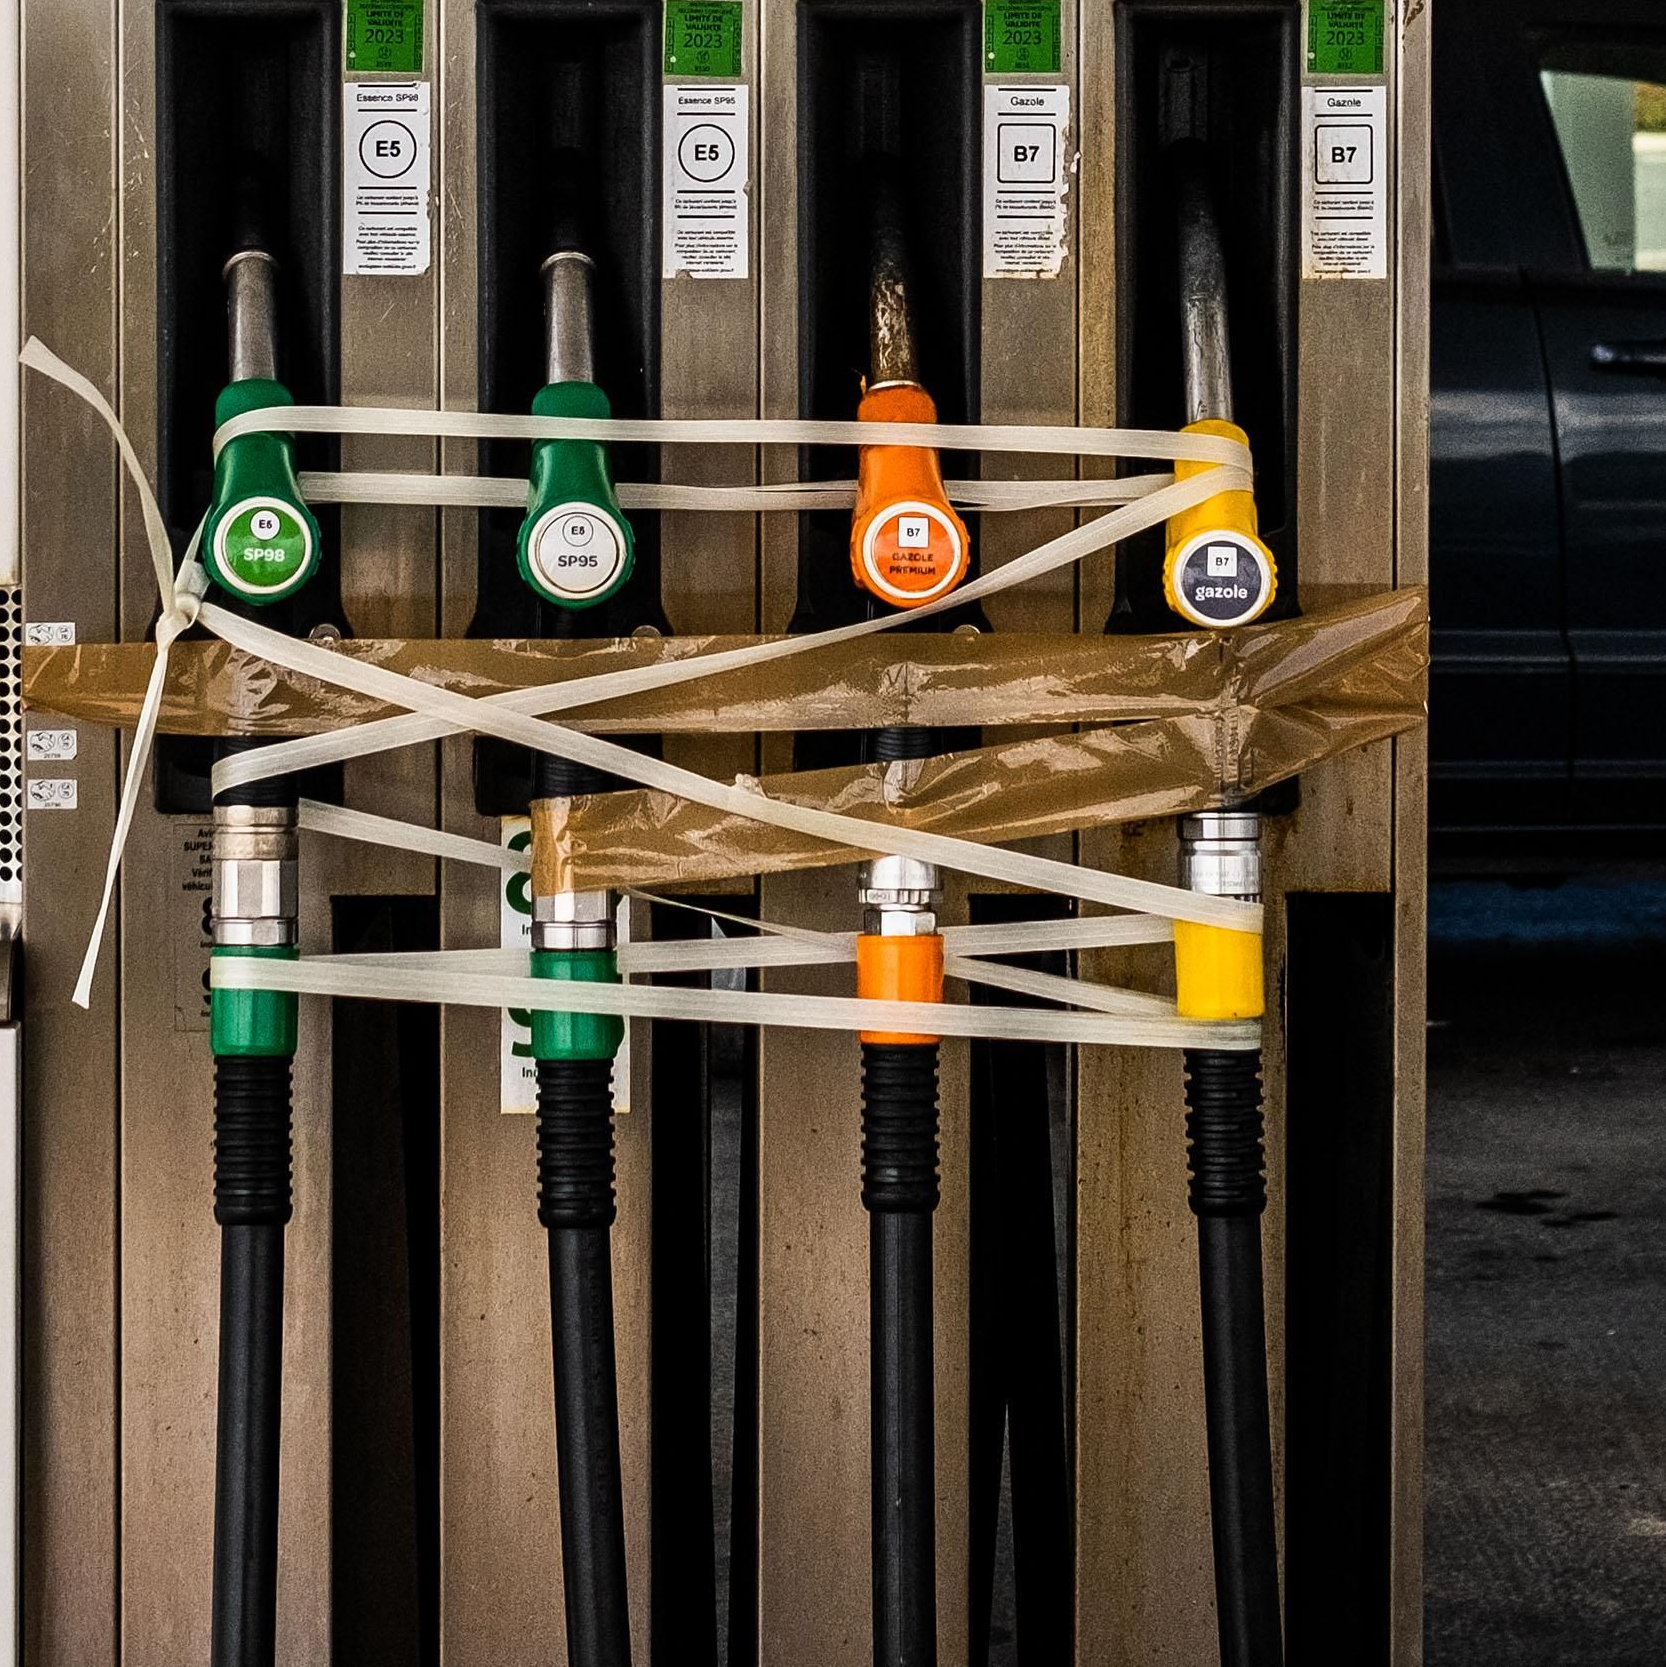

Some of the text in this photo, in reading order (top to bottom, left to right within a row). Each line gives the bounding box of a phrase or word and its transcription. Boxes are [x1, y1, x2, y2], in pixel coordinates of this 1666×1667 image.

[364, 29, 404, 44] 2023
[683, 33, 723, 48] 2023
[1003, 30, 1041, 45] 2023
[1326, 31, 1364, 45] 2023
[356, 94, 393, 102] Essence
[678, 96, 736, 105] Essence SP95
[1010, 96, 1045, 106] Gazole
[1327, 97, 1362, 107] Gazole
[375, 140, 401, 157] E5
[695, 144, 719, 161] E5
[1014, 145, 1040, 162] B7
[1331, 146, 1357, 163] B7
[906, 528, 921, 537] B7
[243, 547, 286, 562] SP98
[558, 555, 598, 567] SP95
[892, 553, 934, 562] GAZOLE
[1215, 557, 1229, 566] B7
[889, 566, 936, 575] PREMIUM
[1195, 584, 1248, 601] gazole
